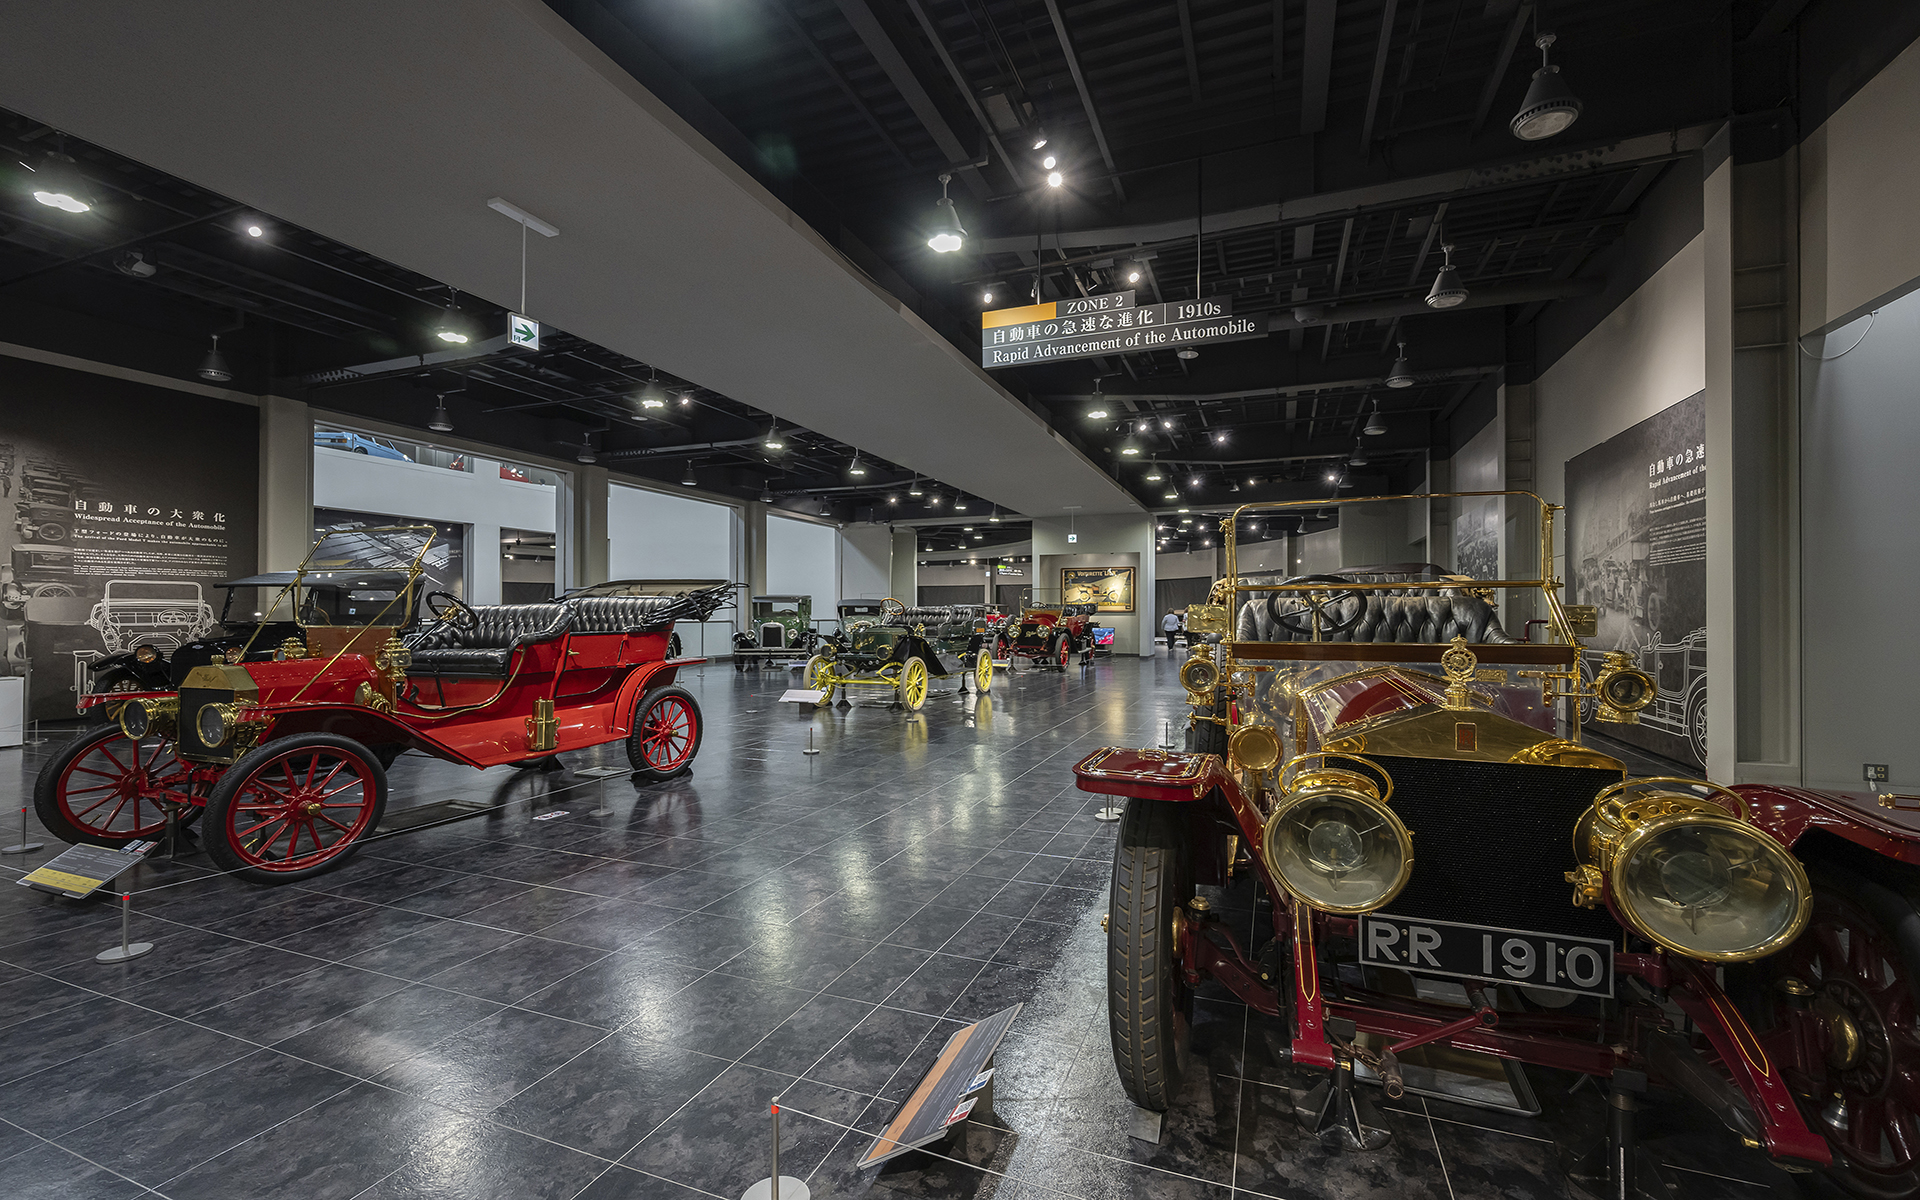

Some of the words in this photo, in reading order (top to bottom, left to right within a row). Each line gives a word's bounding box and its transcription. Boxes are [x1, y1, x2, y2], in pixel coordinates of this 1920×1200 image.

[1067, 297, 1109, 314] ZONE
[1115, 295, 1124, 307] 2
[993, 309, 1154, 344] 自動車の急速な進化
[1178, 301, 1221, 320] 1910s
[993, 346, 1029, 364] Rapid
[1033, 336, 1121, 359] Advancement
[1125, 332, 1141, 347] of
[1145, 330, 1166, 345] the
[1171, 318, 1256, 342] Automobile
[1649, 479, 1662, 489] Rapid
[1662, 470, 1692, 485] Advancement
[74, 513, 121, 523] Widespread
[122, 517, 164, 526] Acceptance
[188, 522, 226, 531] Automobile
[75, 499, 226, 523] 自動車の大衆化
[1482, 933, 1604, 988] 1910
